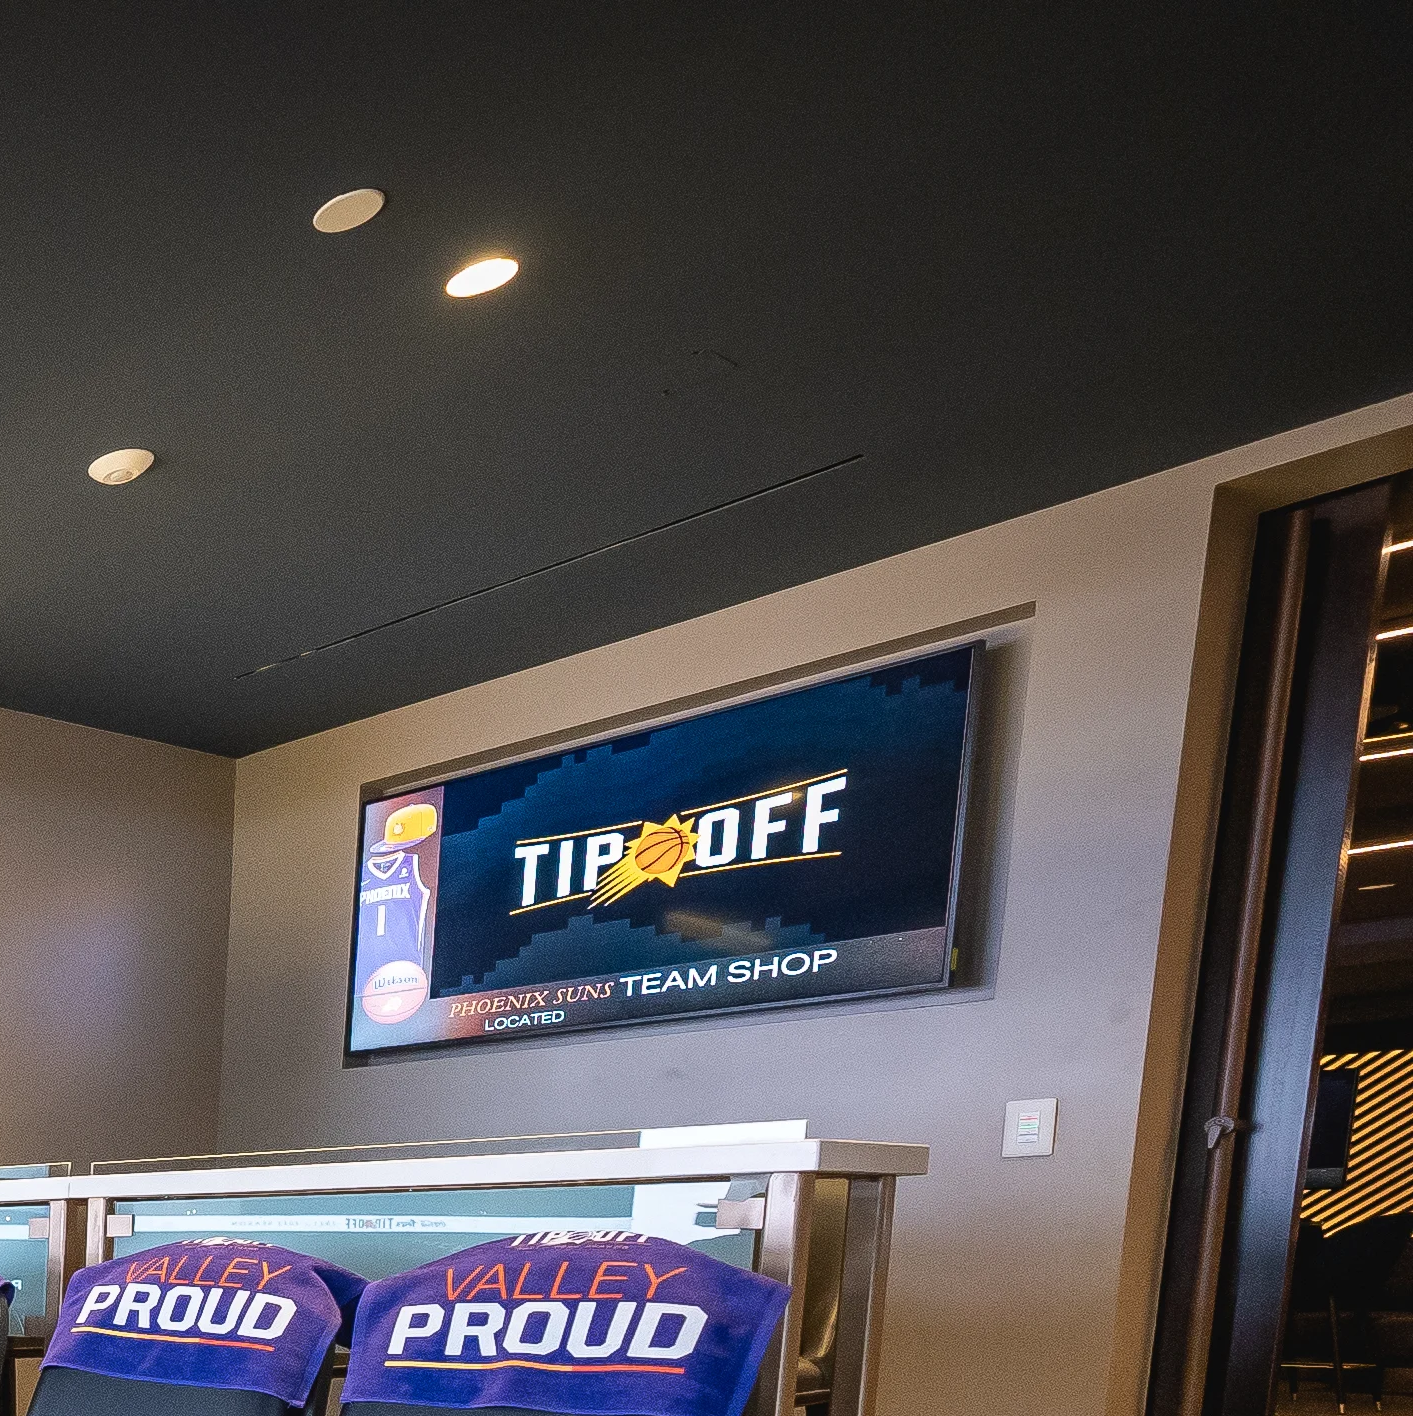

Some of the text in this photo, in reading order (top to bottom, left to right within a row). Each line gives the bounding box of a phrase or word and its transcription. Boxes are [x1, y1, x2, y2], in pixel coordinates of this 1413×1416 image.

[514, 775, 847, 907] TIP OFF
[359, 882, 411, 906] PHOENIX
[376, 904, 386, 937] 1
[448, 948, 839, 1019] PHOENIX SUNS TEAM SHOP
[484, 1009, 566, 1031] LOCATED
[125, 1260, 293, 1292] VALLEY
[446, 1260, 687, 1301] VALLEY
[75, 1283, 298, 1341] PROUD
[386, 1301, 711, 1360] PROUD
